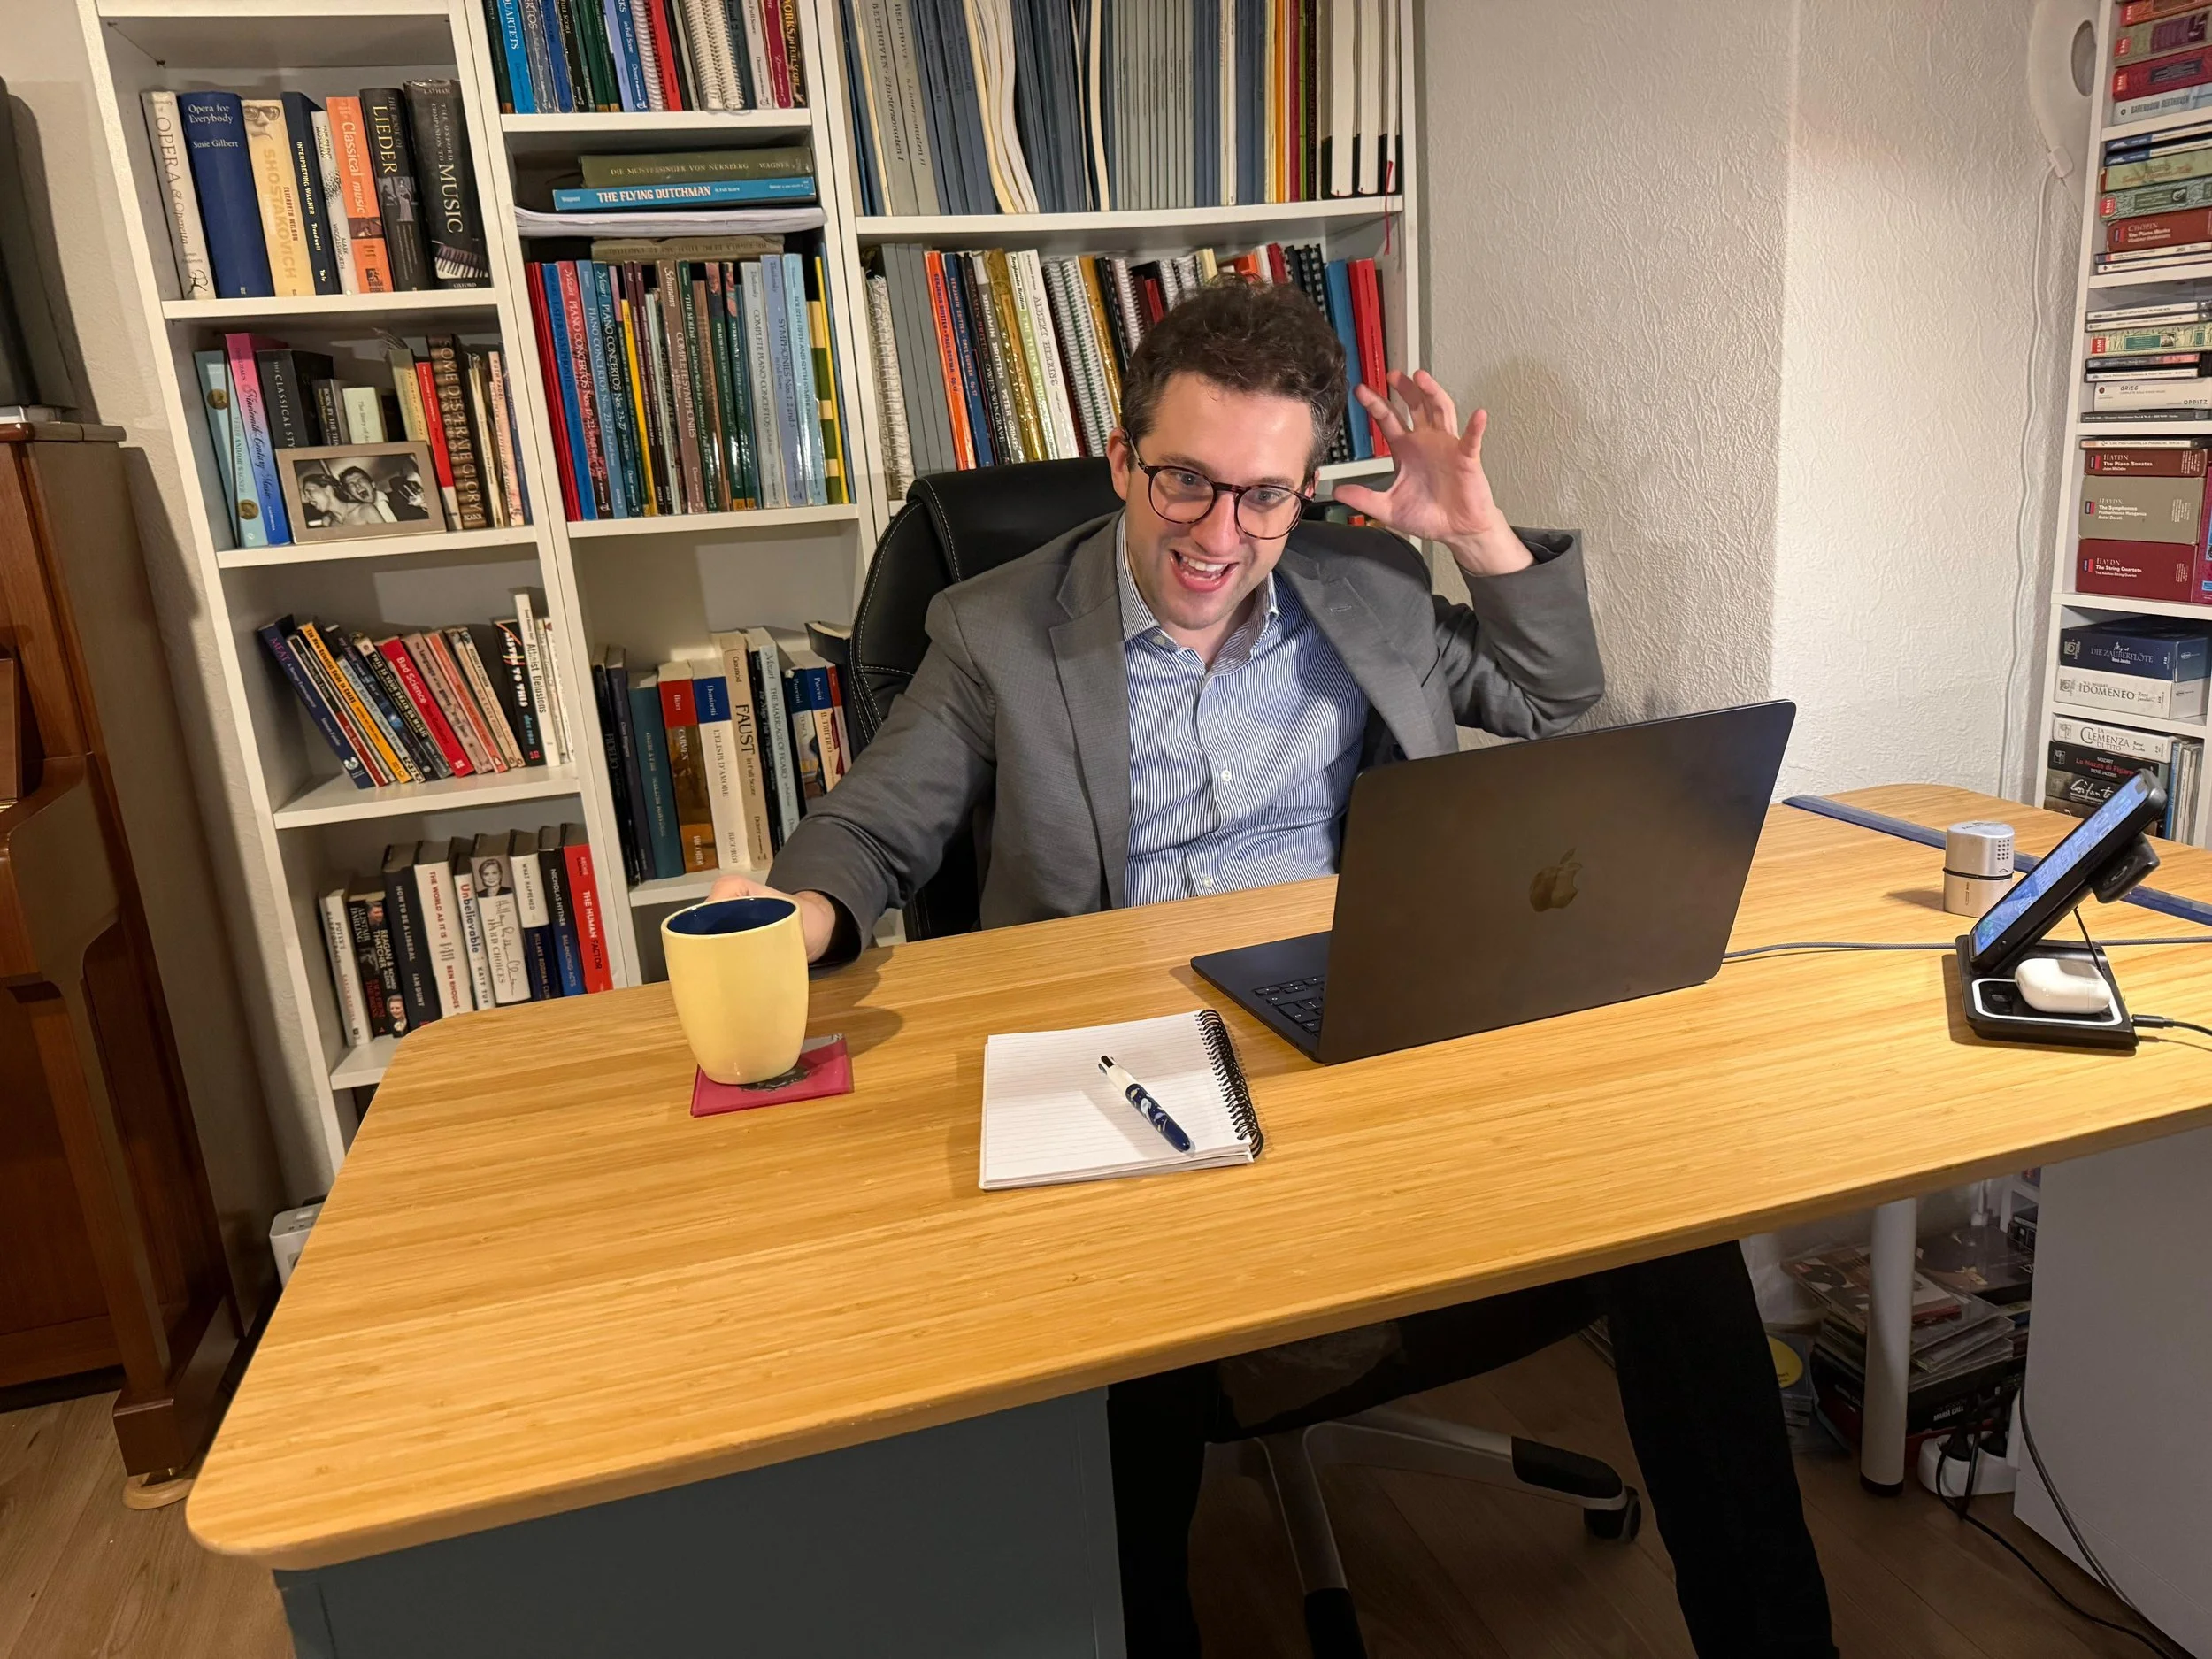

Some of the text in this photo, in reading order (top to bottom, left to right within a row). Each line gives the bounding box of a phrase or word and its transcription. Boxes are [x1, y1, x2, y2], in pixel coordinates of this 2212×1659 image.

[872, 3, 889, 70] BEETHOVEN
[188, 104, 214, 116] Opera
[189, 114, 234, 124] Everybody
[154, 115, 183, 184] OPERA
[212, 139, 239, 148] Gilbert
[342, 120, 363, 177] Classical
[373, 104, 398, 174] LIEDER
[296, 142, 310, 187] INTERPRETING
[304, 188, 315, 216] WAGNER
[352, 180, 366, 214] music
[596, 187, 711, 204] THE FLYING DUTCHMAN
[263, 147, 297, 280] SHOSTAKOVICH
[436, 161, 465, 234] MUSIC
[601, 303, 613, 336] PIANO
[568, 300, 589, 388] PIANO CONCERTOS
[663, 266, 697, 438] Schumann COMPLETE SYMPHONIES
[778, 319, 791, 377] SYMPHONIES
[981, 293, 996, 338] BENJAMIN
[991, 342, 1004, 379] BRITTEN
[1001, 389, 1012, 417] PETER
[605, 336, 622, 391] CONCERTOS
[273, 373, 292, 427] CLASSICAL
[985, 363, 1005, 442] OWEN WINGRAVE
[447, 384, 473, 460] DESPERATE
[462, 463, 484, 510] GLORY
[269, 636, 290, 663] MEAT
[2091, 648, 2103, 657] DIE
[396, 656, 428, 705] Bad Science
[512, 667, 523, 682] TO
[813, 677, 824, 700] Puccini
[2079, 683, 2135, 700] IDOMENEO
[371, 653, 384, 669] THIS
[380, 667, 388, 676] IS
[412, 718, 428, 739] MUSIC
[516, 683, 528, 708] THIS
[532, 675, 549, 713] Delusions
[672, 694, 683, 711] Bizet
[706, 685, 718, 716] Donizetti
[732, 656, 755, 755] Gounod FAUST
[764, 651, 788, 779] Mozart THE MARRIAGE OF FIGARO
[676, 729, 688, 761] CARMEN
[727, 832, 739, 864] RICORDI
[396, 886, 404, 902] HOW
[399, 903, 406, 913] TO
[432, 887, 442, 910] WORLD
[550, 869, 566, 926] NICHOLAS HYTNER
[350, 907, 364, 943] DARLING
[401, 914, 409, 924] BE
[436, 913, 443, 923] AS
[459, 884, 481, 953] Unbelievable
[582, 891, 603, 970] THE HUMAN FACTOR
[373, 931, 387, 968] THATCHER
[380, 929, 392, 960] REAGAN
[404, 931, 416, 961] LIBERAL
[492, 947, 506, 984] CHOICES
[415, 987, 425, 1007] DUNT
[449, 981, 460, 1009] RHODES
